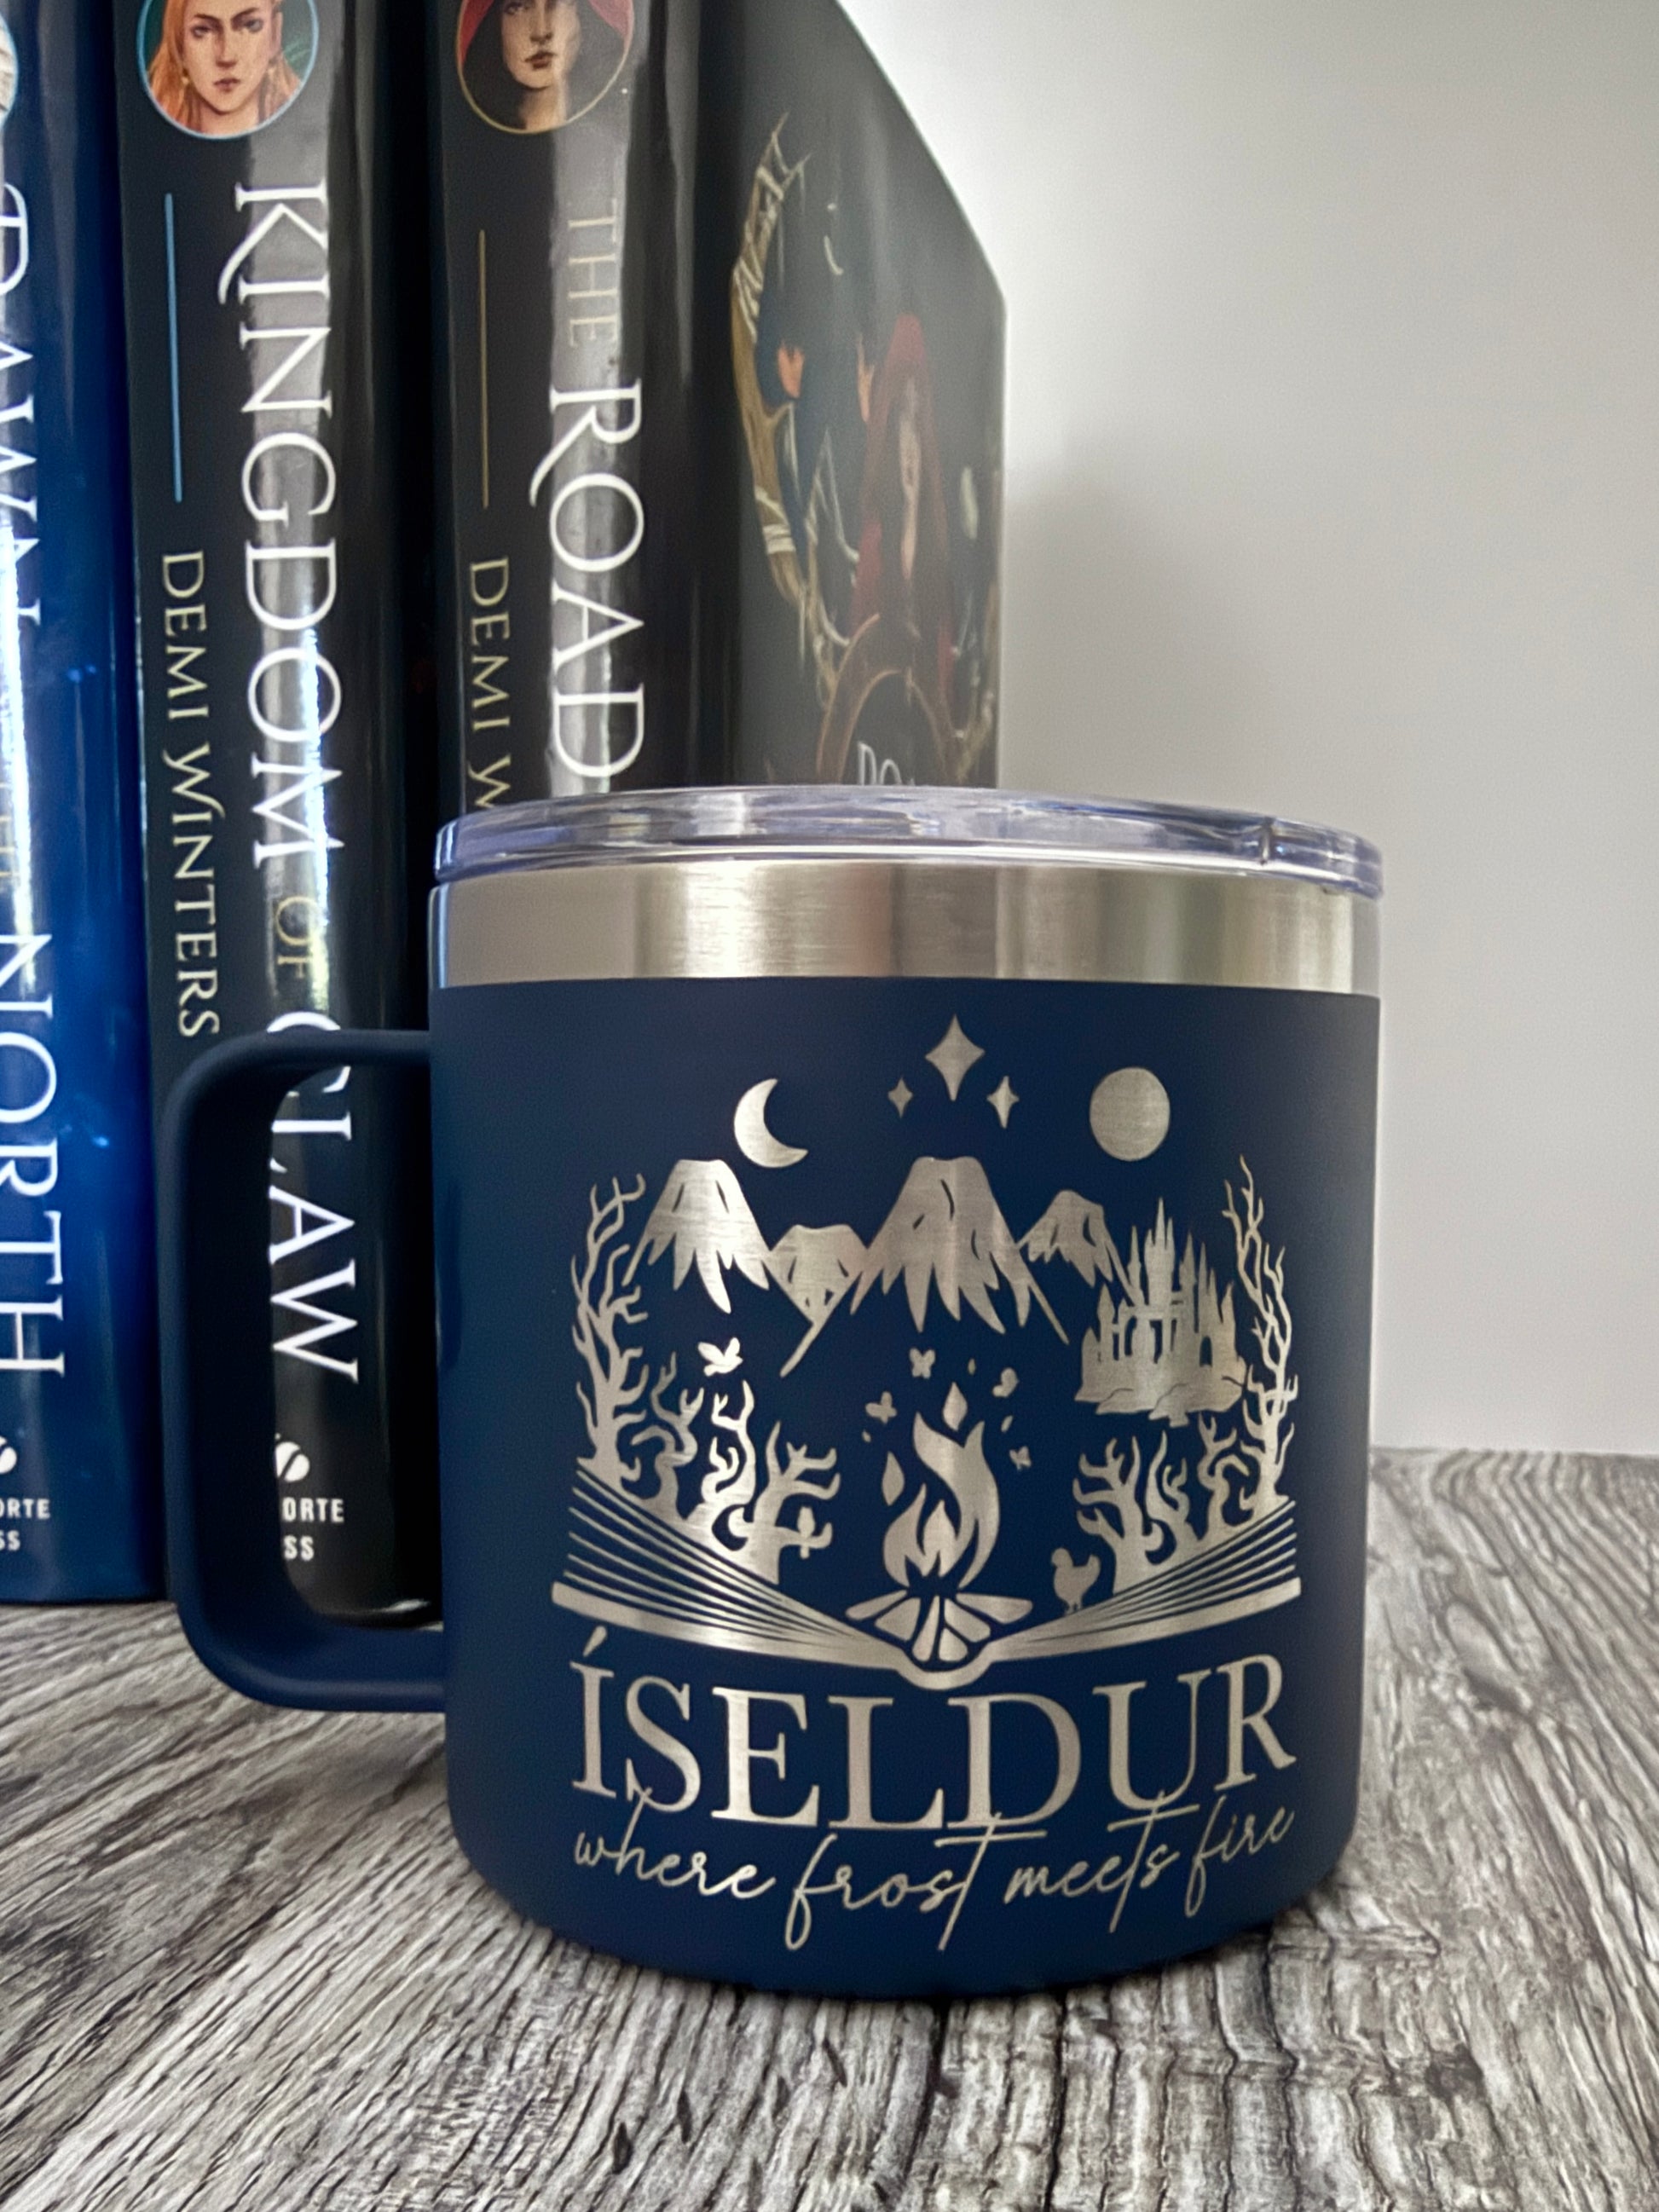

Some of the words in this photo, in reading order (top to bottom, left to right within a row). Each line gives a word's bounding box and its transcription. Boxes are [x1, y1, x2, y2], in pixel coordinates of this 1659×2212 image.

[569, 197, 618, 347] THE
[219, 178, 344, 869] KINGDOM
[529, 378, 645, 777] ROAD
[162, 551, 209, 720] DEMI
[471, 558, 510, 731] DEMI
[163, 743, 225, 1038] WINTERS
[275, 896, 327, 979] OF
[569, 1626, 1297, 1830] ÍSELDUR
[575, 1788, 776, 1899] where
[785, 1812, 1047, 1950] frost
[1004, 1791, 1199, 1932] meets
[1185, 1794, 1295, 1917] fire
